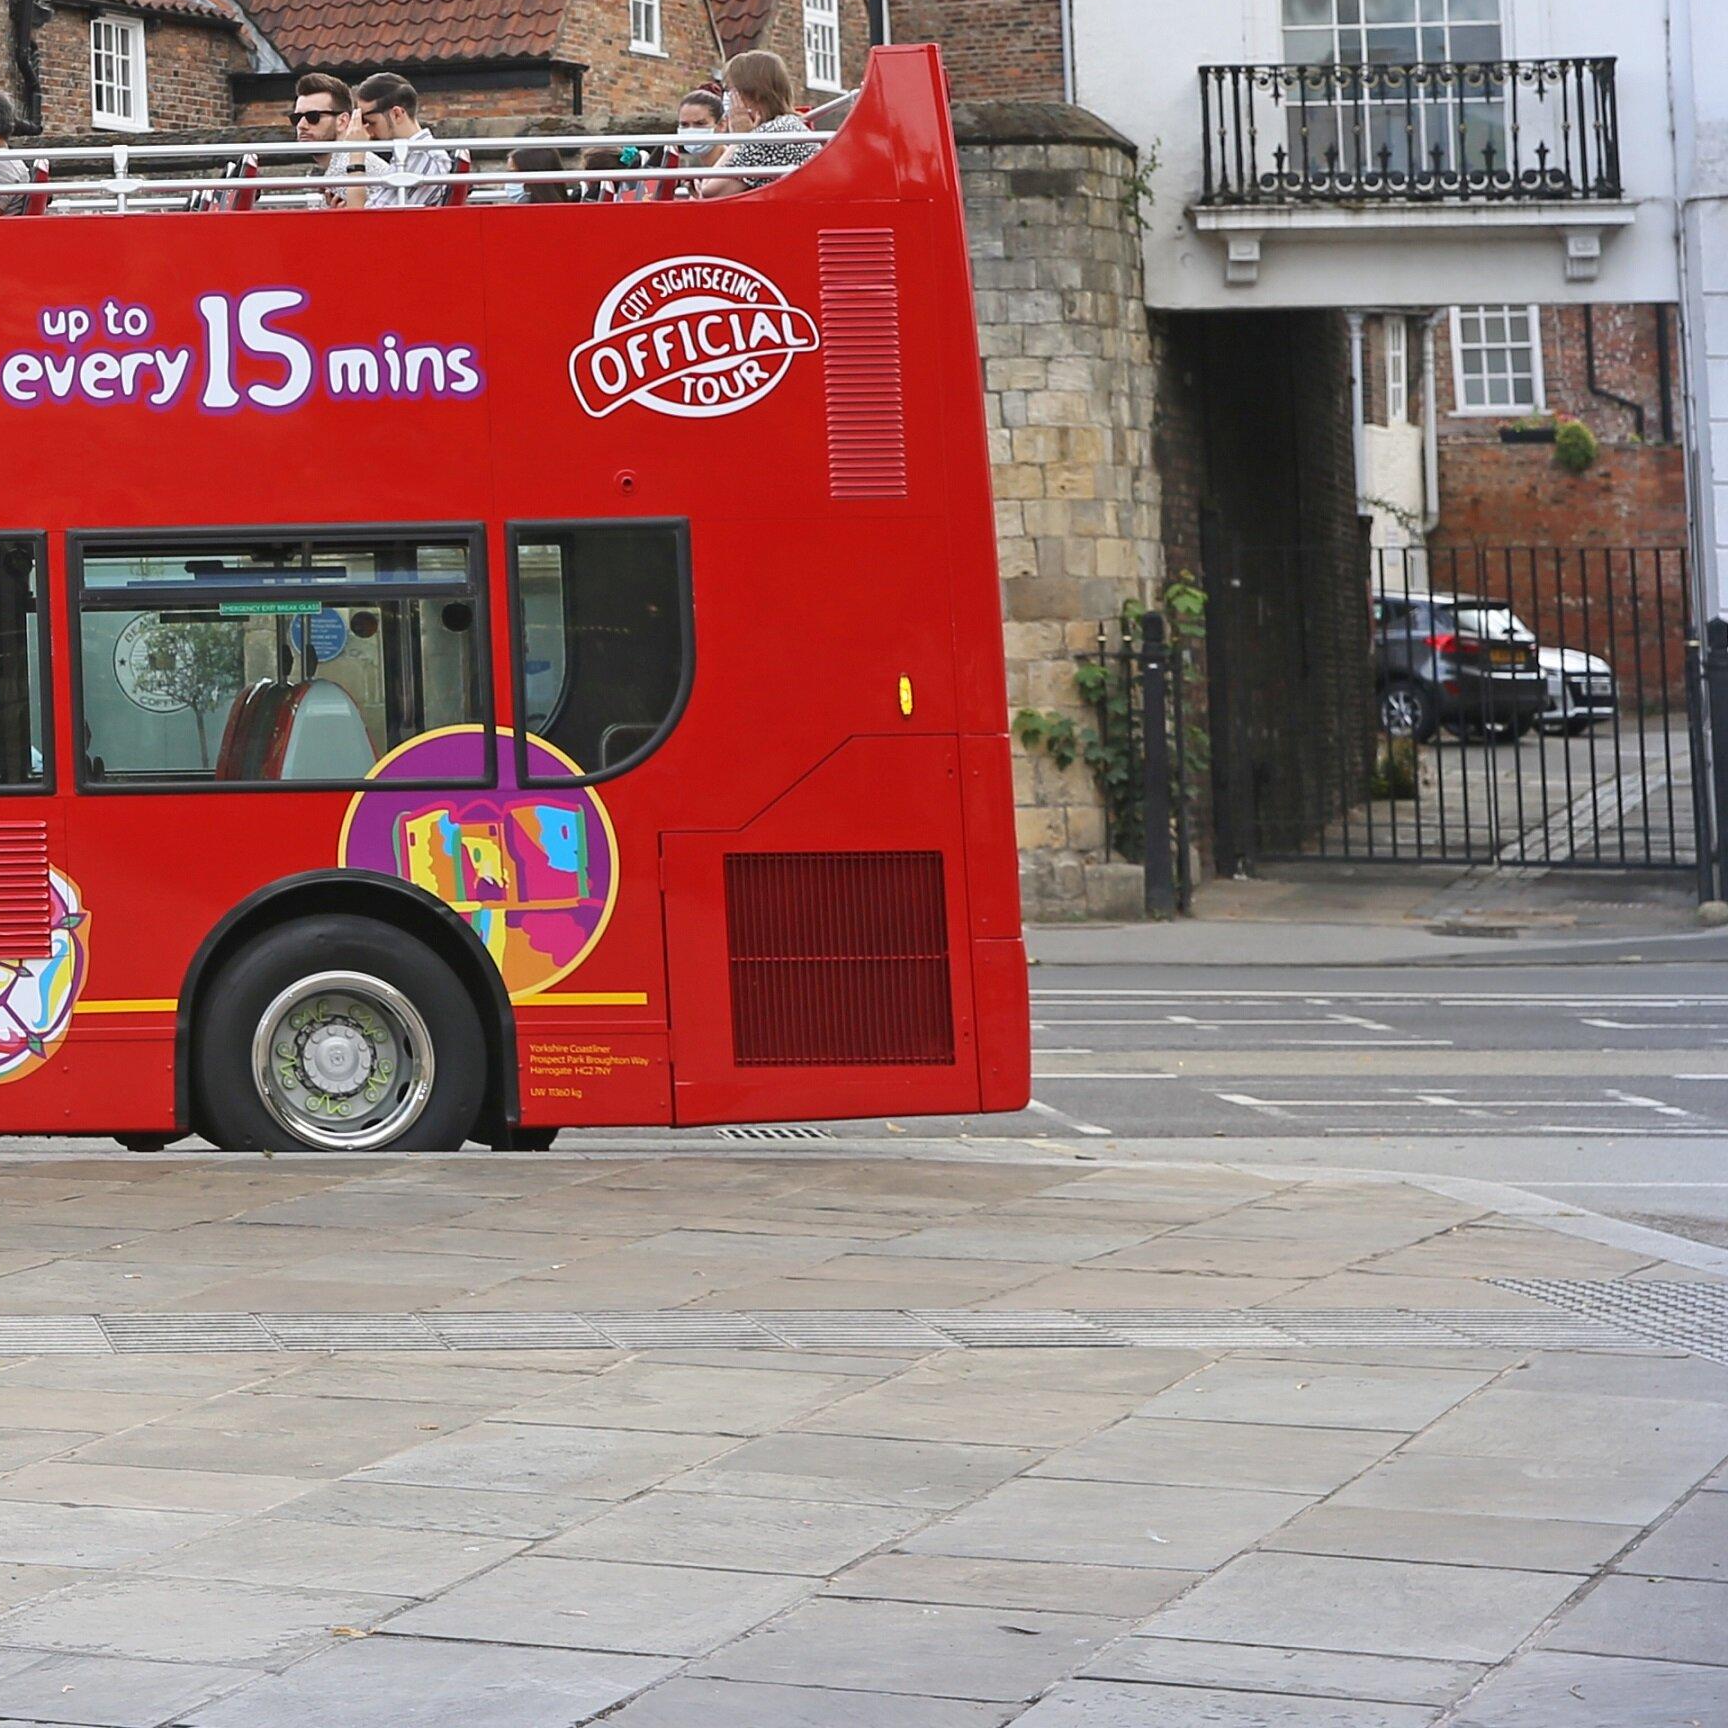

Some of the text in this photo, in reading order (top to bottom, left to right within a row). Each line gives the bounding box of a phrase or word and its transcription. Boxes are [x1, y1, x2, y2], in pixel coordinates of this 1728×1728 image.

[619, 266, 762, 321] CITY SIGHTSEEING
[43, 301, 147, 342] up to
[2, 289, 480, 408] every 15 mins
[590, 311, 809, 395] OFFICIAL
[680, 359, 770, 405] TOUR
[277, 604, 298, 612] BREAK
[529, 1044, 611, 1053] Yorkshire Coastliner
[530, 1055, 649, 1066] Prospect Park Broughton Way
[530, 1067, 573, 1076] Harrogate
[571, 1087, 583, 1099] kg
